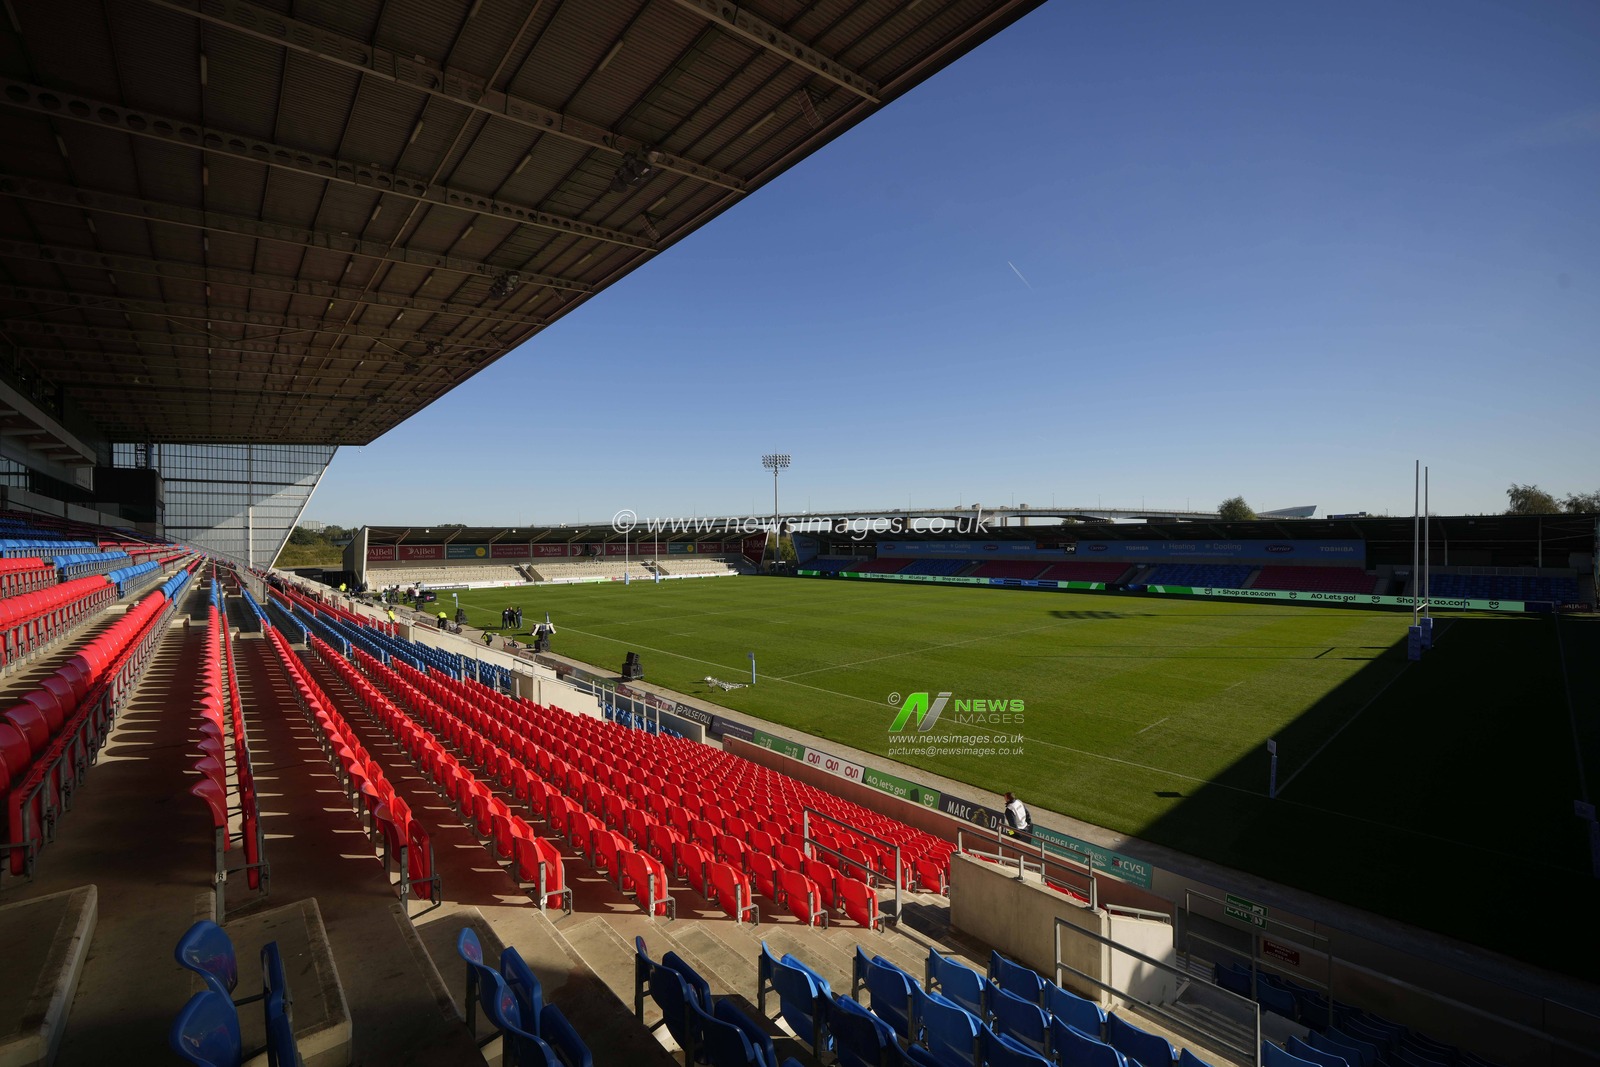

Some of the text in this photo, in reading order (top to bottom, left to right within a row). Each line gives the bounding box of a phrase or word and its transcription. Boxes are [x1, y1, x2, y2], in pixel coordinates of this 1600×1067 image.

[1343, 595, 1356, 603] go!
[1396, 596, 1420, 605] Shop
[1433, 599, 1470, 607] ao.com
[866, 775, 907, 797] AO, let's go!
[946, 800, 972, 820] MARC
[1122, 860, 1147, 876] CVSL
